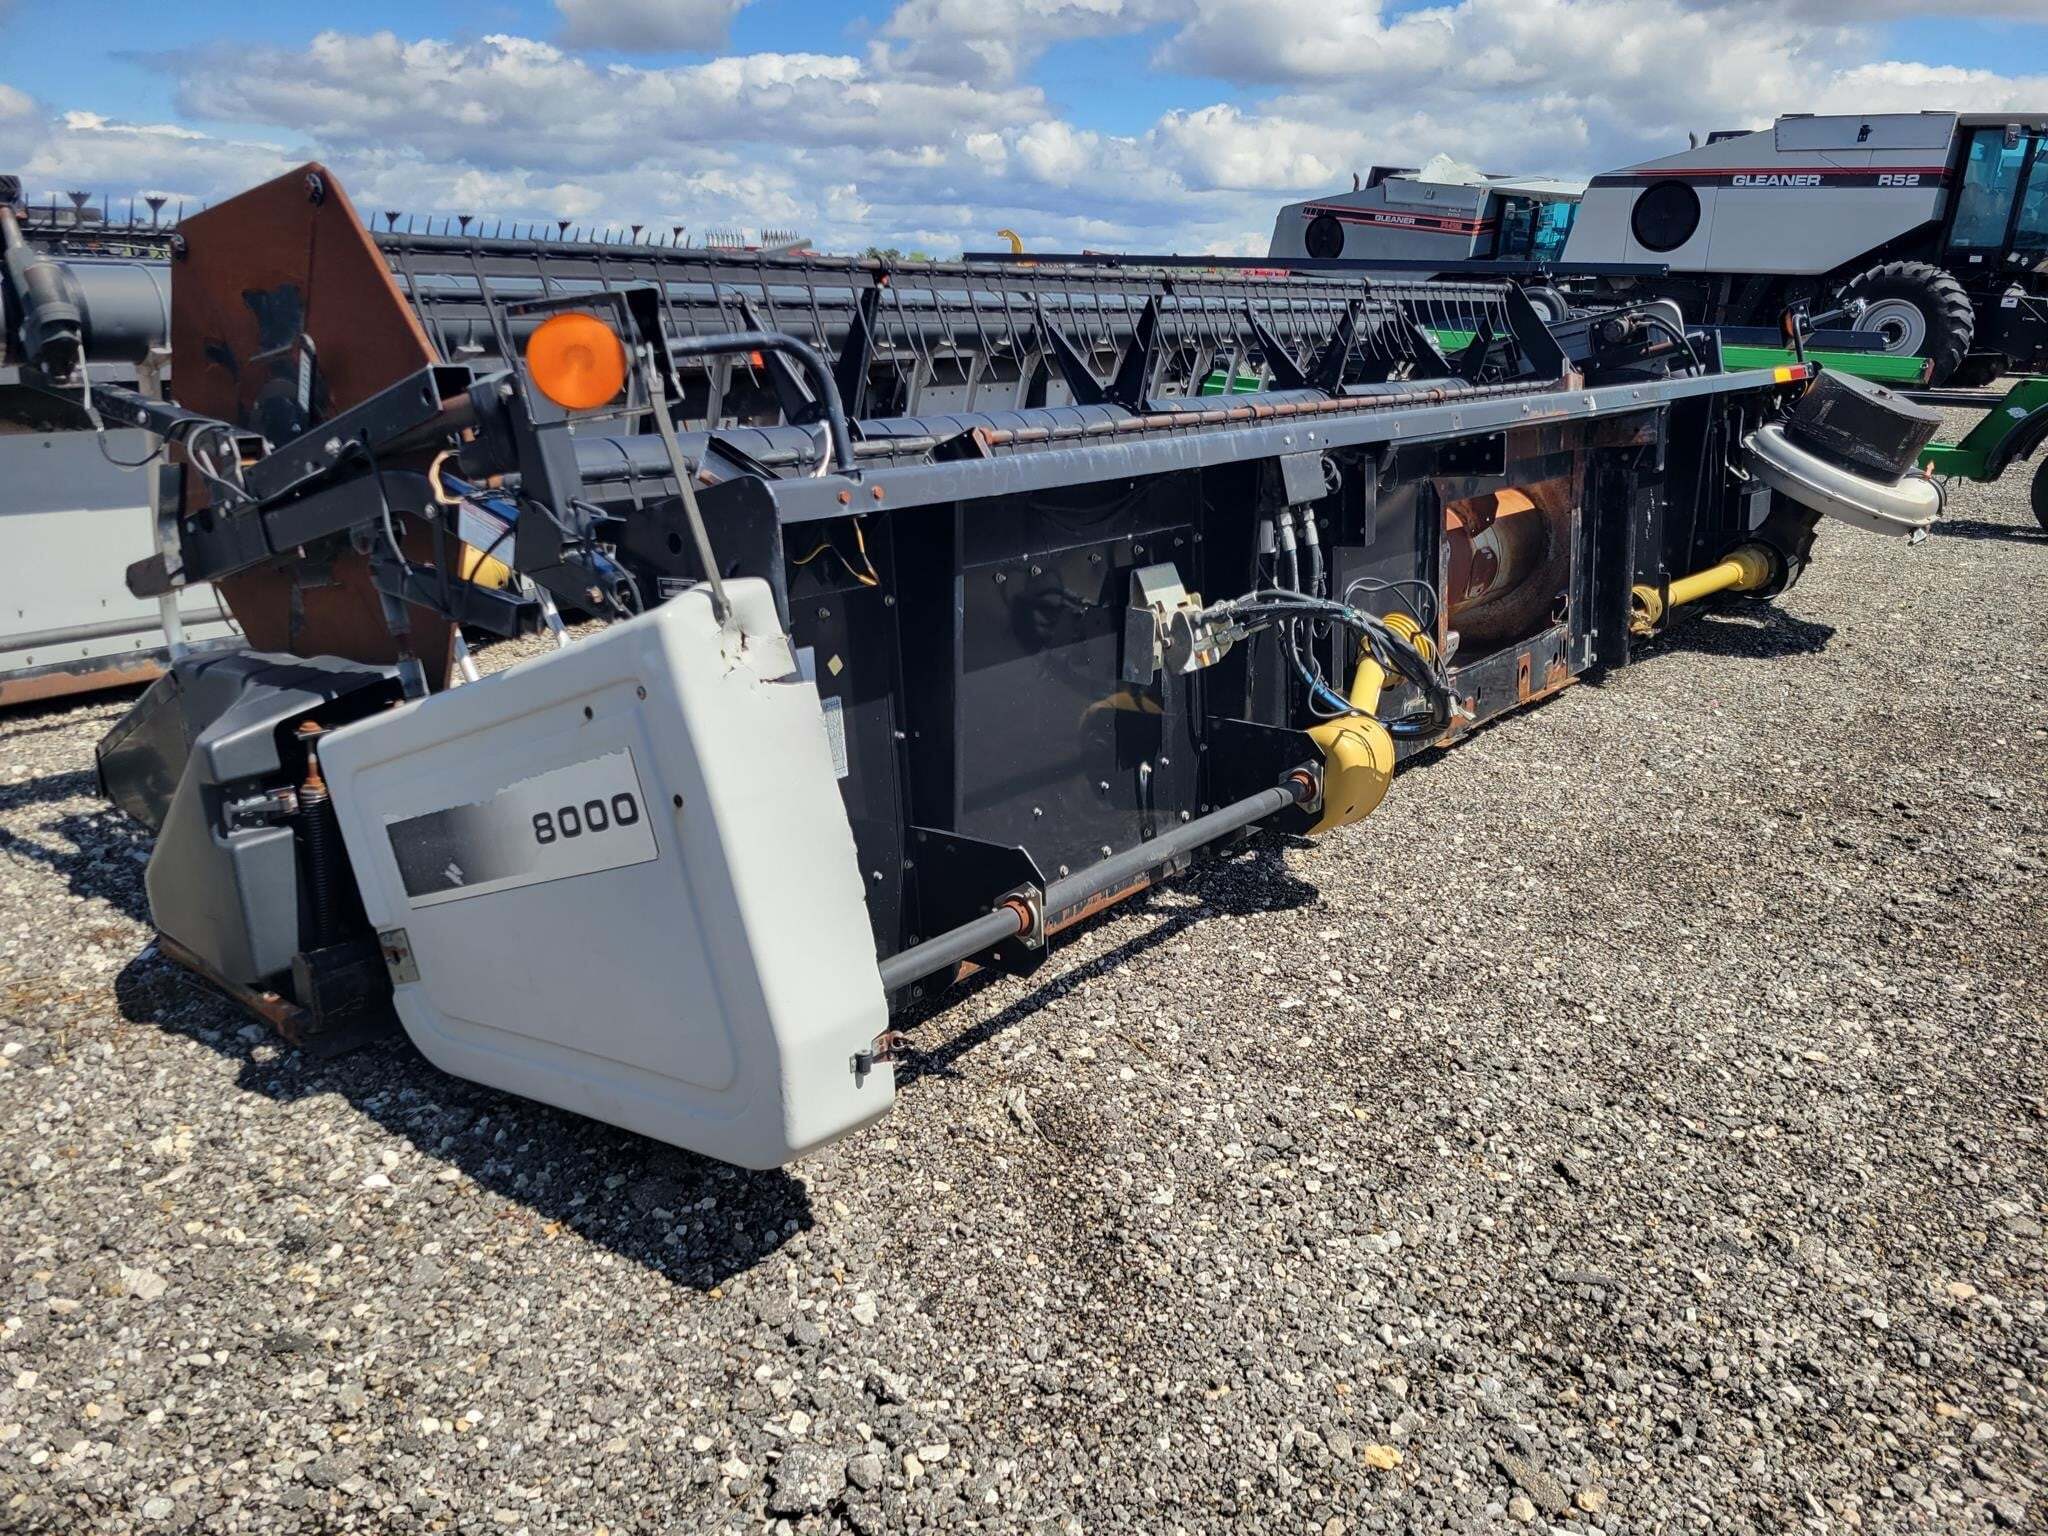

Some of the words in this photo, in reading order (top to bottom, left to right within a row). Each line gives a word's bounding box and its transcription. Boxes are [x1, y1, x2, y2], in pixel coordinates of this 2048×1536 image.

[1732, 174, 1821, 186] GLEANER
[1878, 174, 1920, 186] R52
[1374, 214, 1416, 225] GLEANER
[532, 792, 639, 845] 8000
